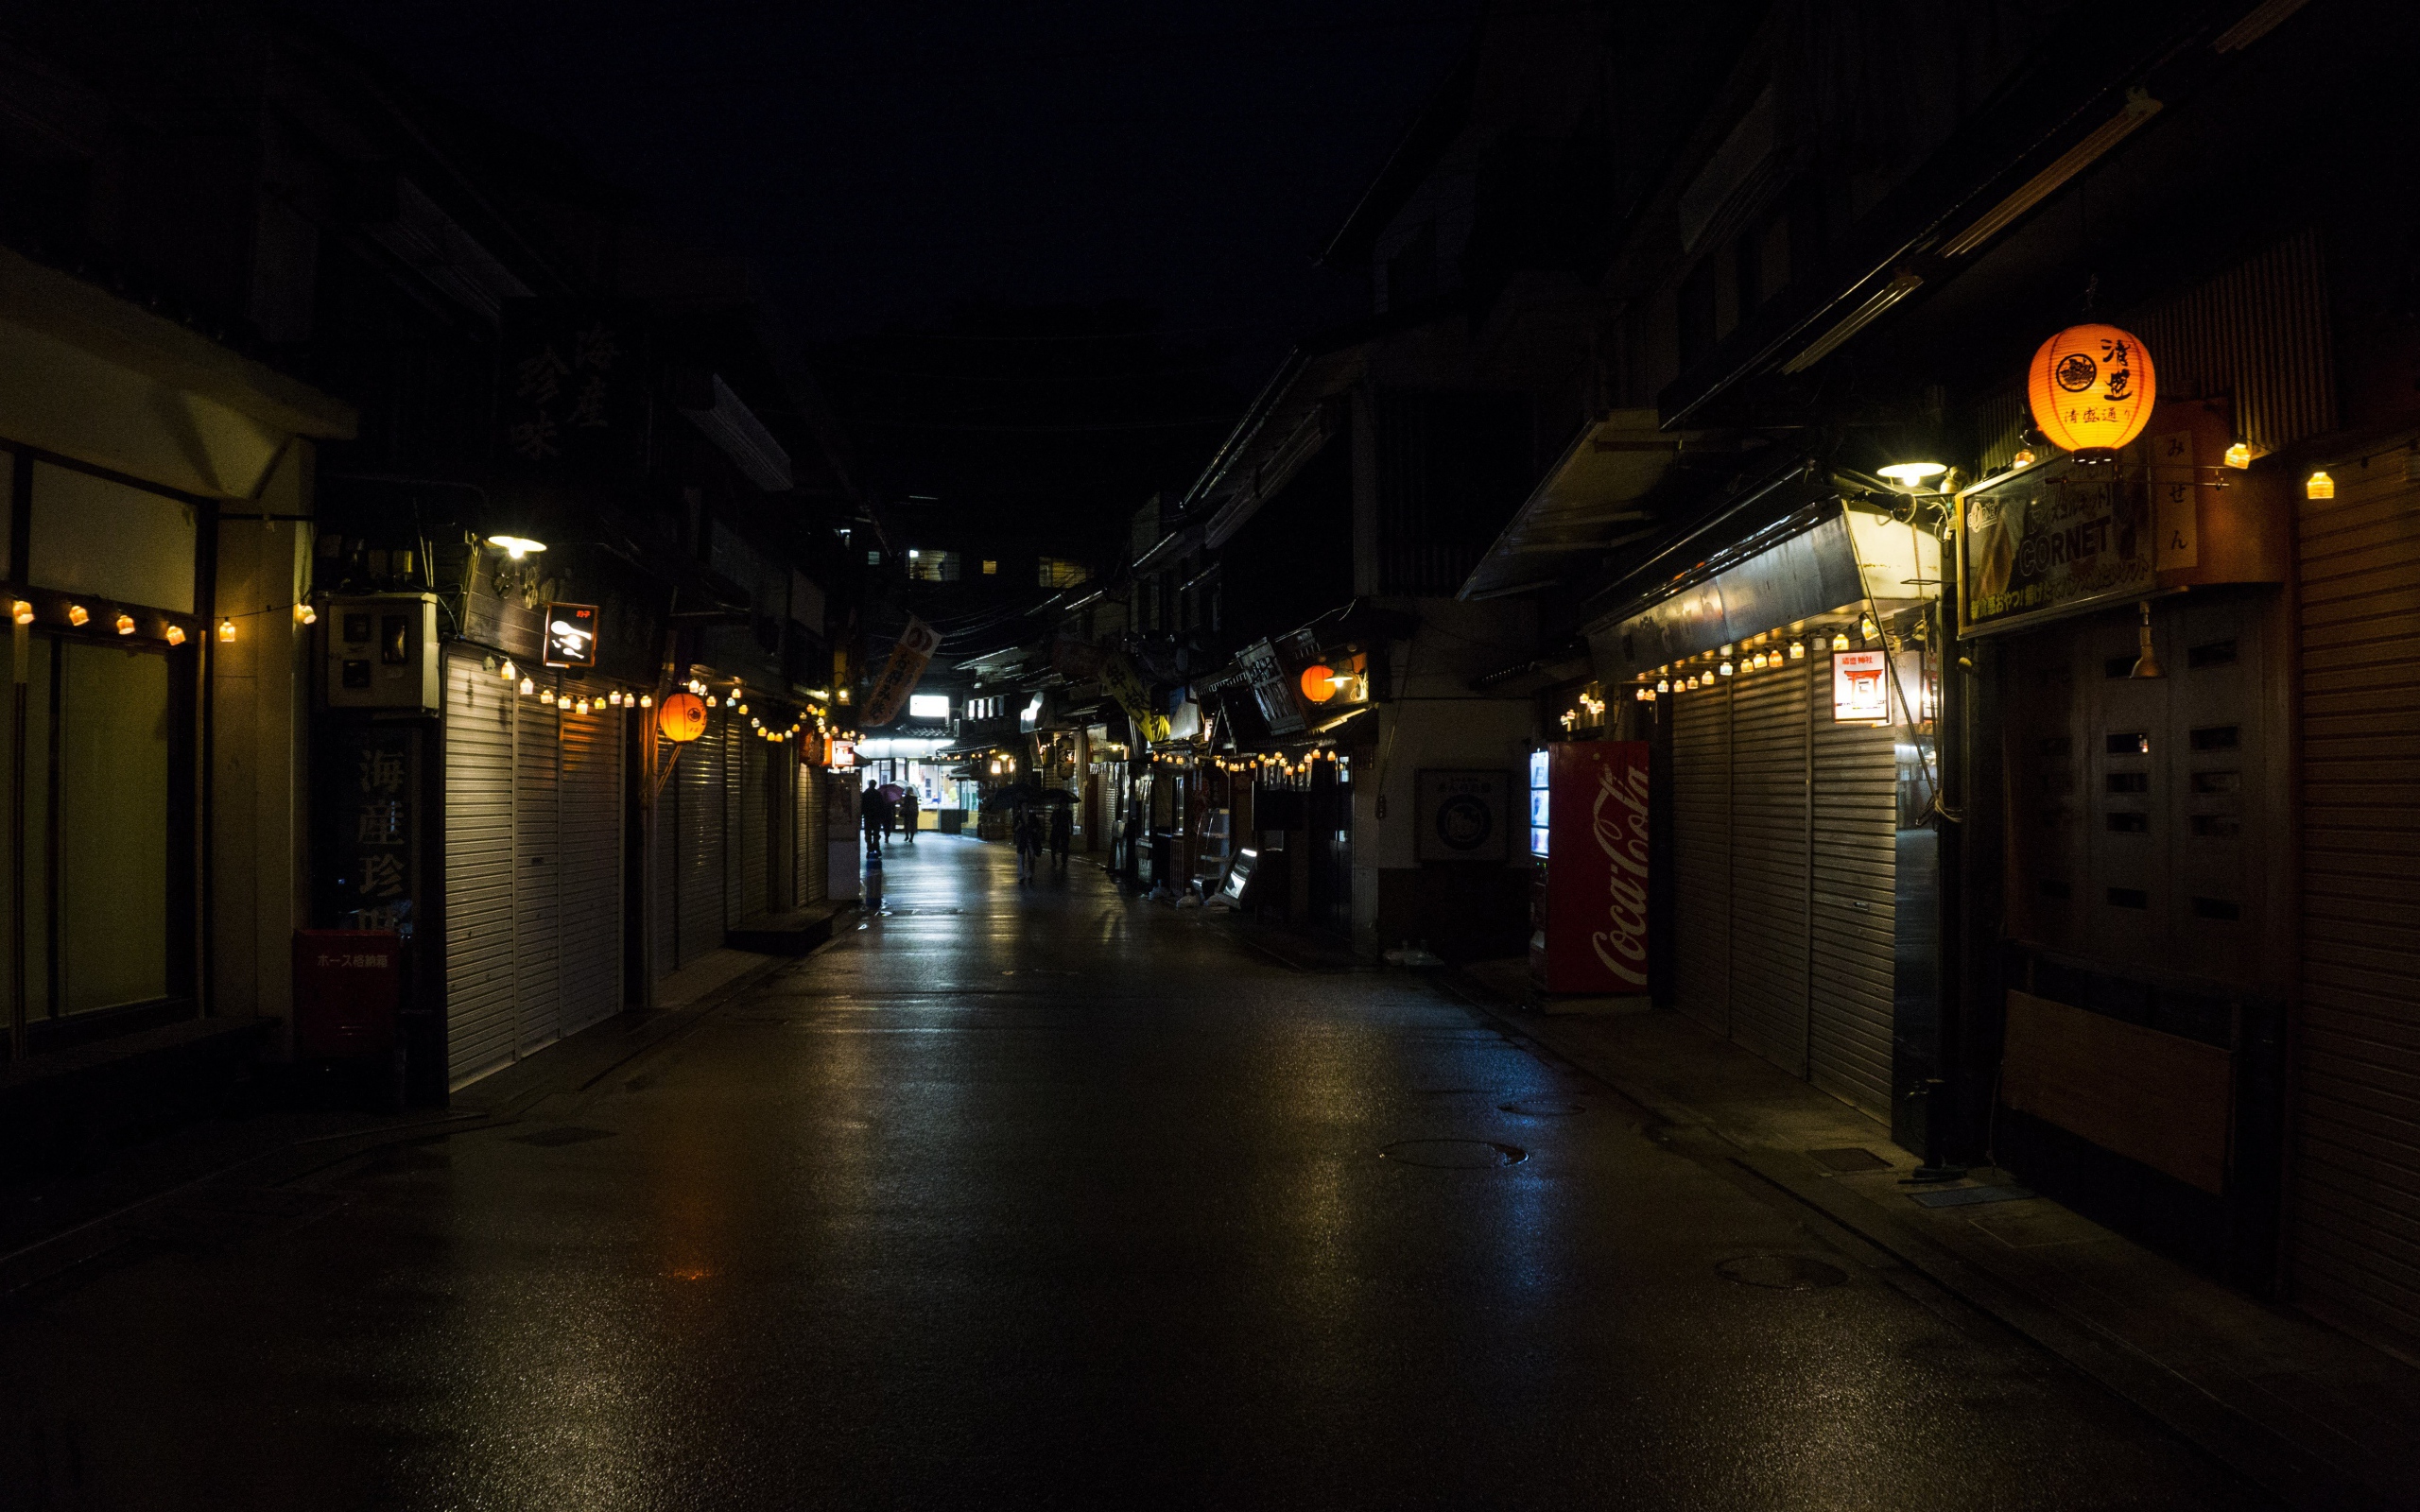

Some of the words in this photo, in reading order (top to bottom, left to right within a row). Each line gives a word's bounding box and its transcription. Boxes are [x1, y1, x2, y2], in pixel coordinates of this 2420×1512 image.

[2019, 515, 2112, 576] CORNET
[1592, 762, 1650, 986] Coca-Cola
[316, 953, 389, 969] ホース格納箱
